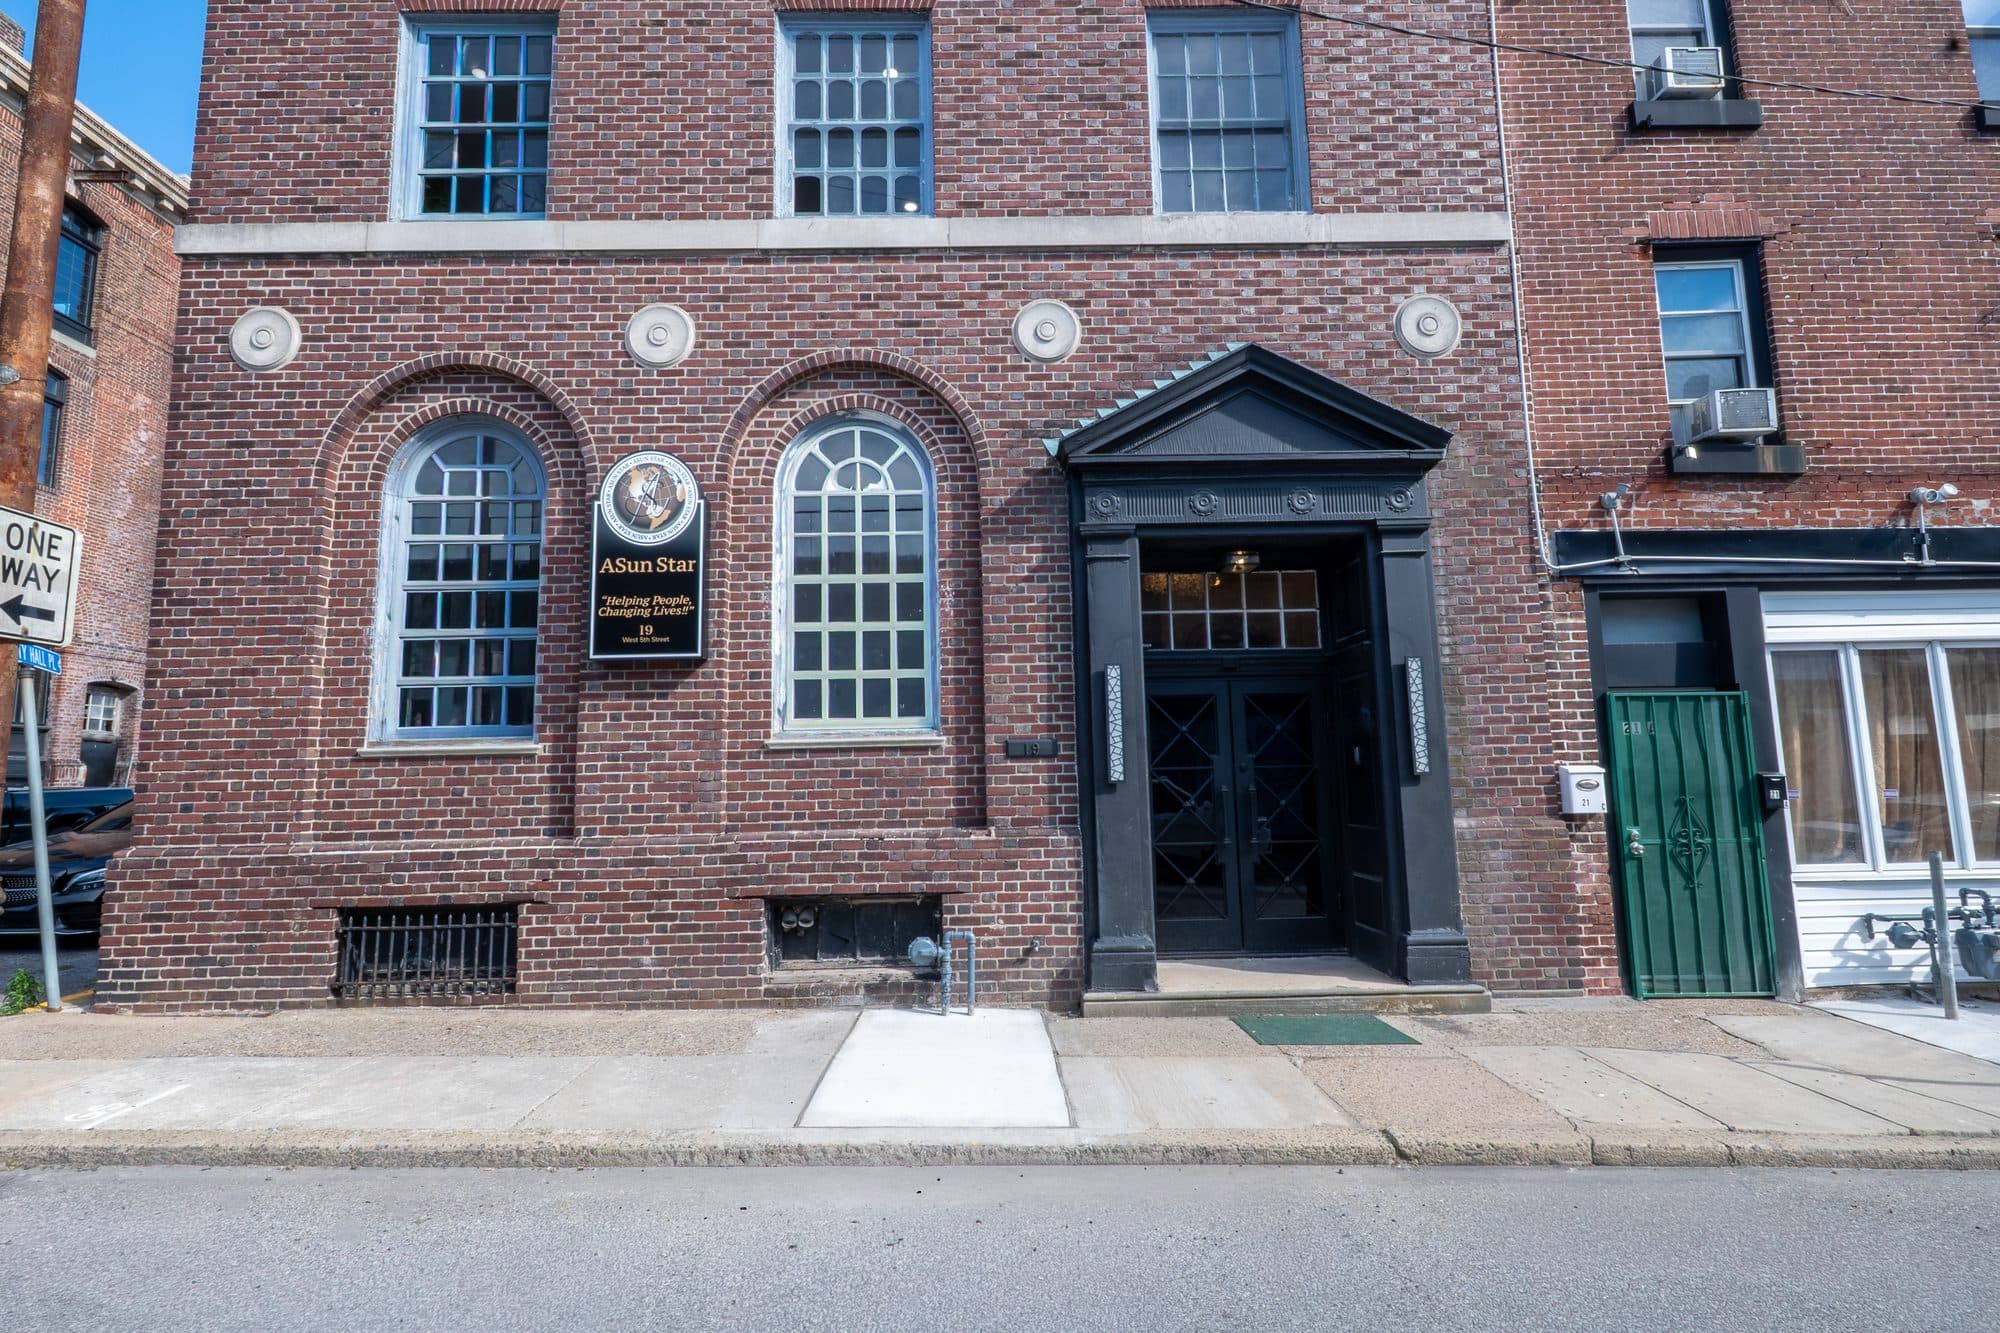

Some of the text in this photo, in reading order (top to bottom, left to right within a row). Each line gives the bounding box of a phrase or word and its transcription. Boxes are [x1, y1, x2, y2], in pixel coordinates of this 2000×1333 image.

[6, 522, 62, 562] ONE
[600, 557, 696, 573] ASun Star
[2, 555, 60, 594] WAY
[602, 594, 692, 607] “Helping People,
[598, 606, 694, 618] Changing Lives!!”
[640, 624, 654, 636] 19
[30, 646, 46, 666] HALL
[48, 653, 56, 670] PL
[1024, 742, 1040, 756] 19
[1582, 798, 1590, 807] 21
